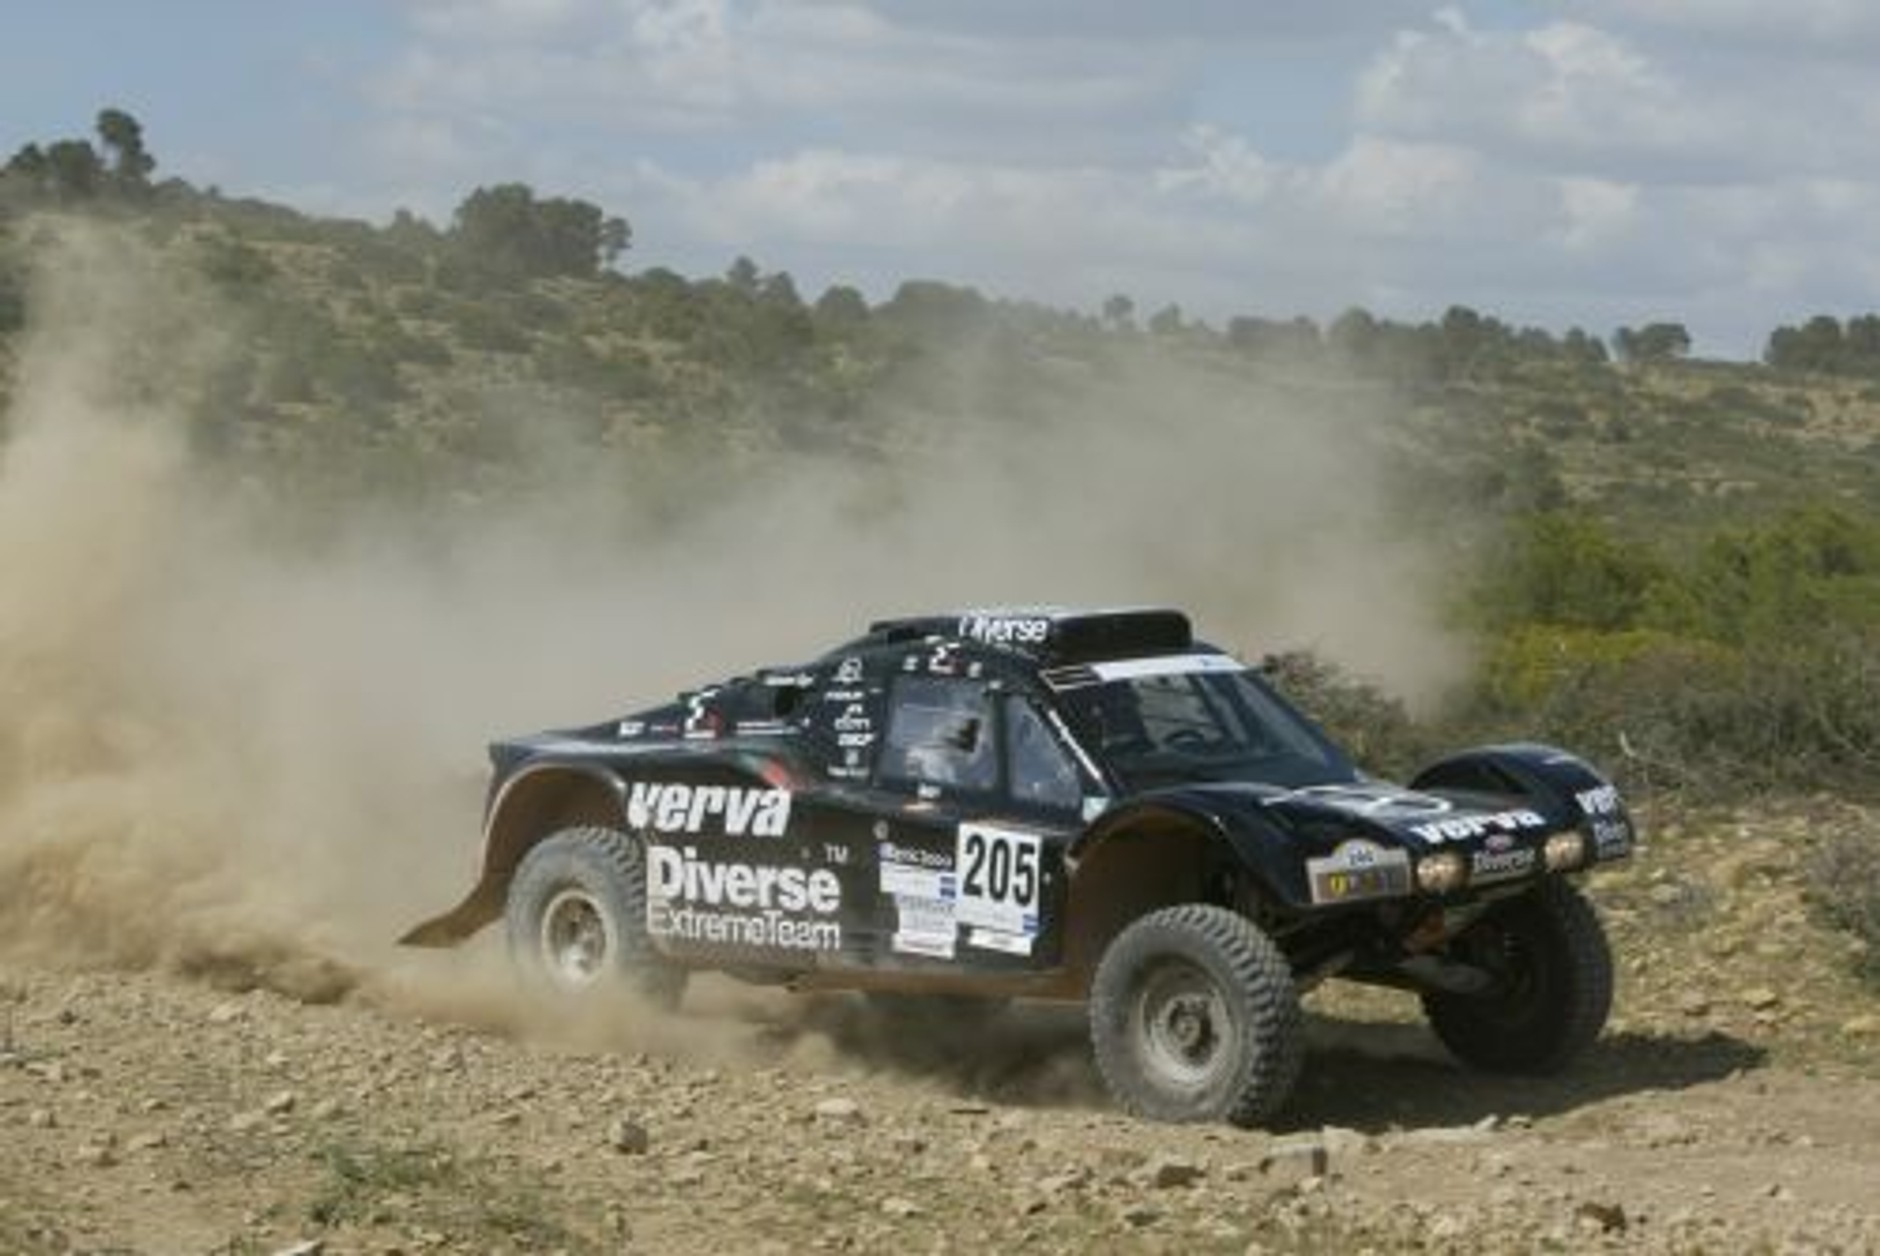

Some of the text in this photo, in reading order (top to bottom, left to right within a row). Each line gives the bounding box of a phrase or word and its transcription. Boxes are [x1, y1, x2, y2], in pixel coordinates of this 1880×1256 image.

[628, 783, 791, 838] verva
[647, 846, 841, 913] Diverse
[963, 833, 1034, 907] 205
[647, 900, 841, 950] ExtremeTeam
